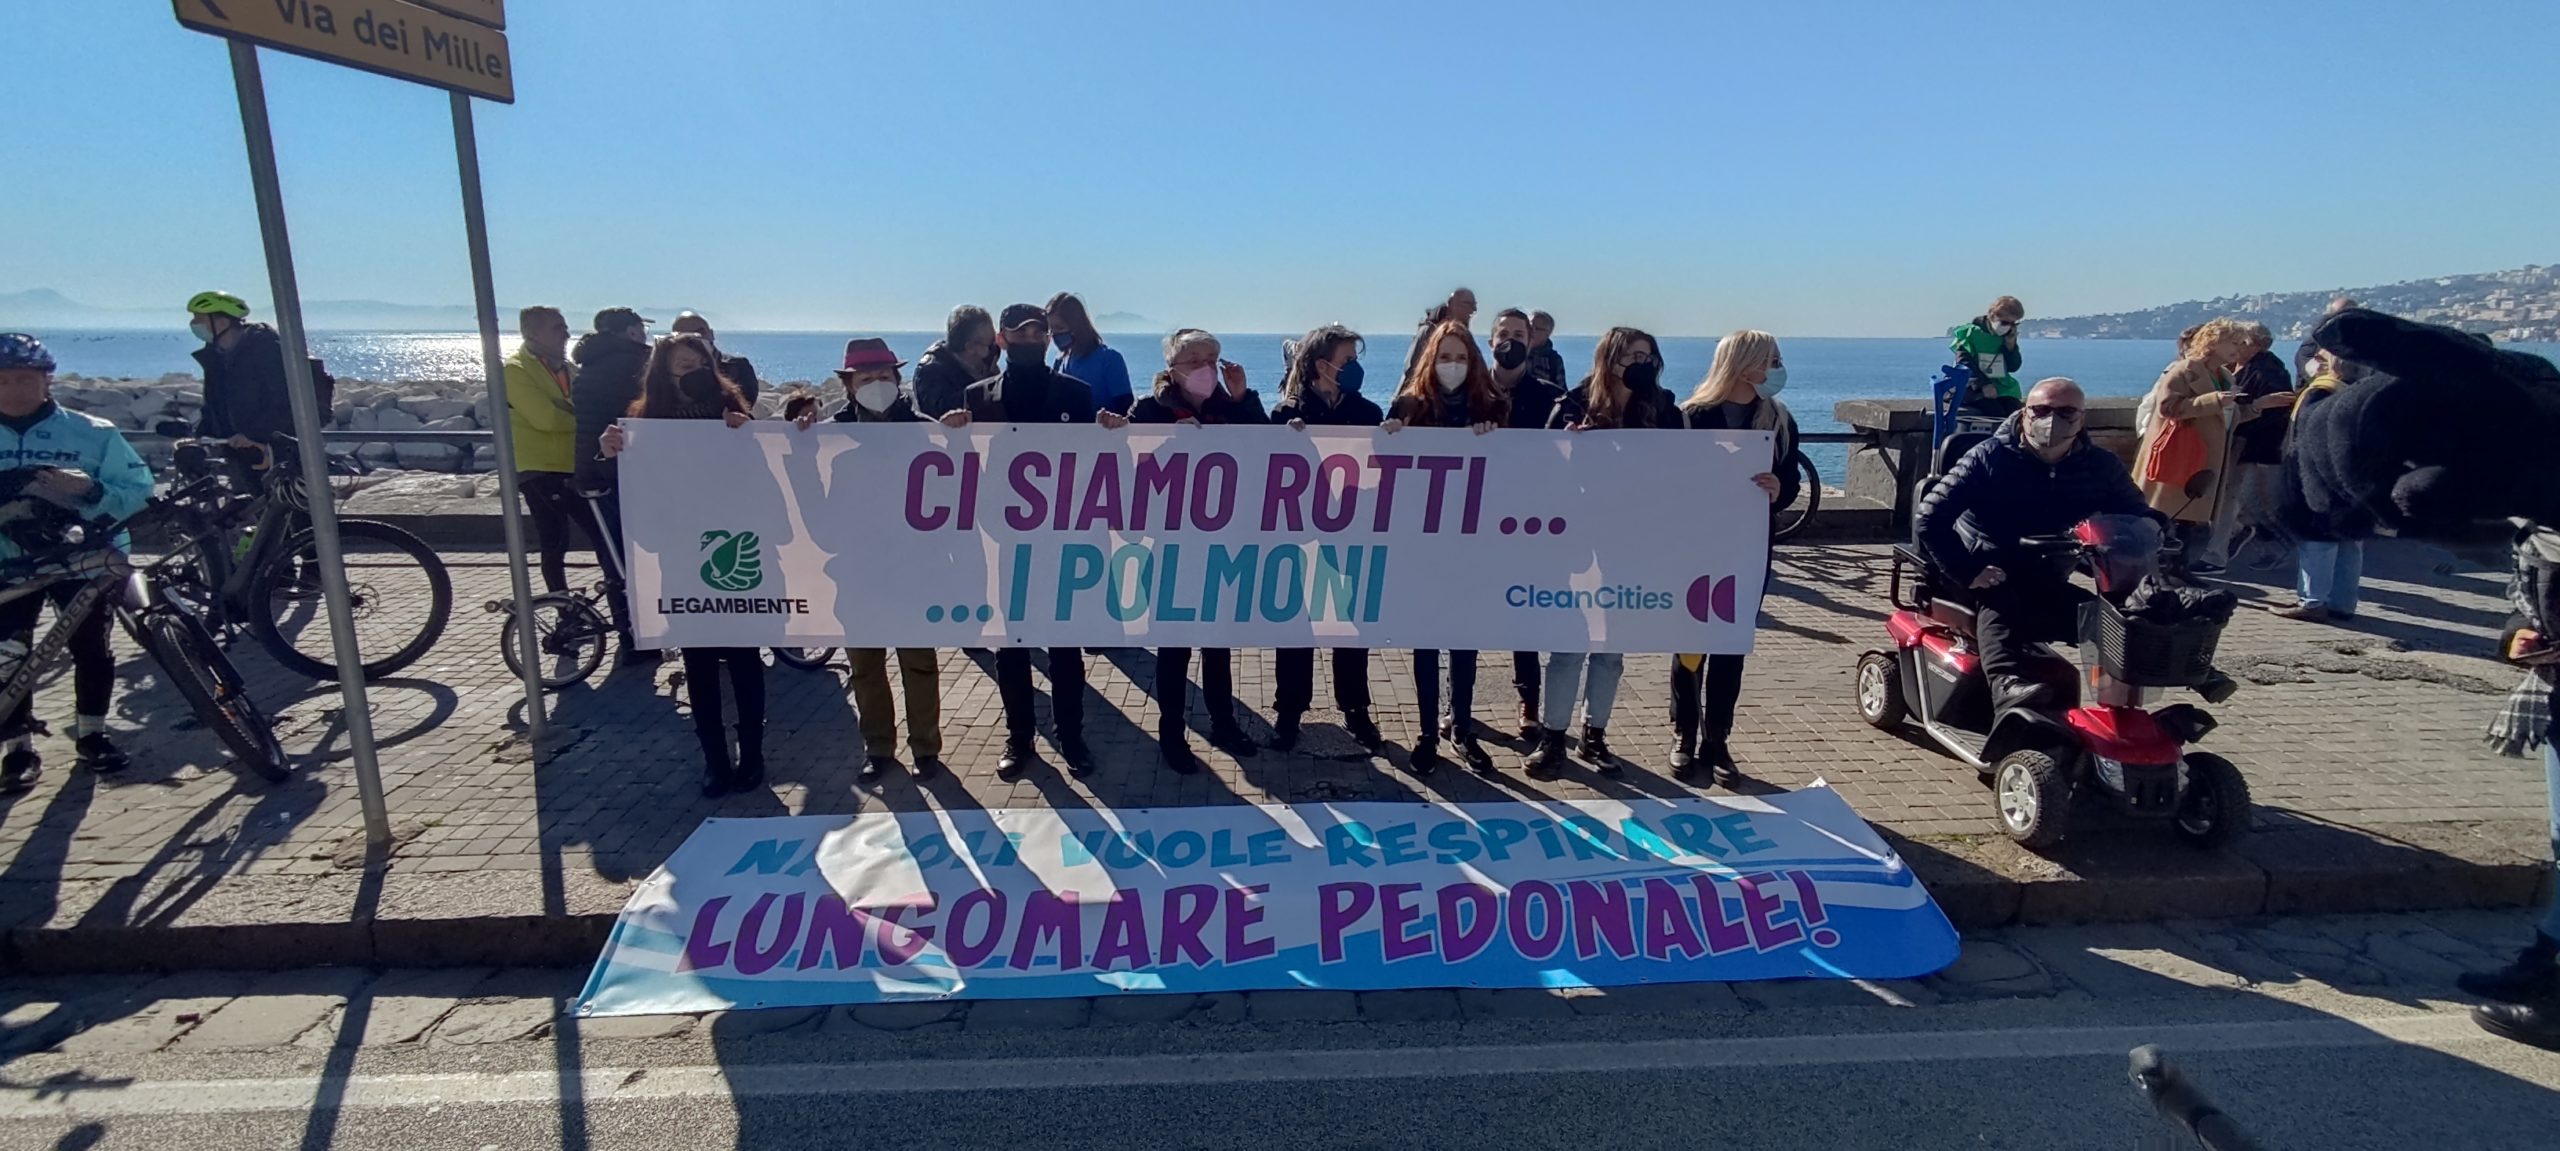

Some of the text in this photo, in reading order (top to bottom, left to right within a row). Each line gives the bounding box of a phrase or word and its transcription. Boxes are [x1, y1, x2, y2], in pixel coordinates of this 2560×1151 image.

[274, 0, 503, 78] Via dei Mille
[904, 451, 980, 532] CI
[1004, 451, 1239, 532] SIAMO
[657, 598, 809, 615] LEGAMBIENTE
[1055, 543, 1388, 623] POLMONI
[1505, 584, 1674, 610] CleanCities
[7, 590, 93, 699] ROCKRIDER
[1060, 829, 1292, 870] VUOLE
[675, 870, 1840, 976] LUNGOMARE PEDONALE!
